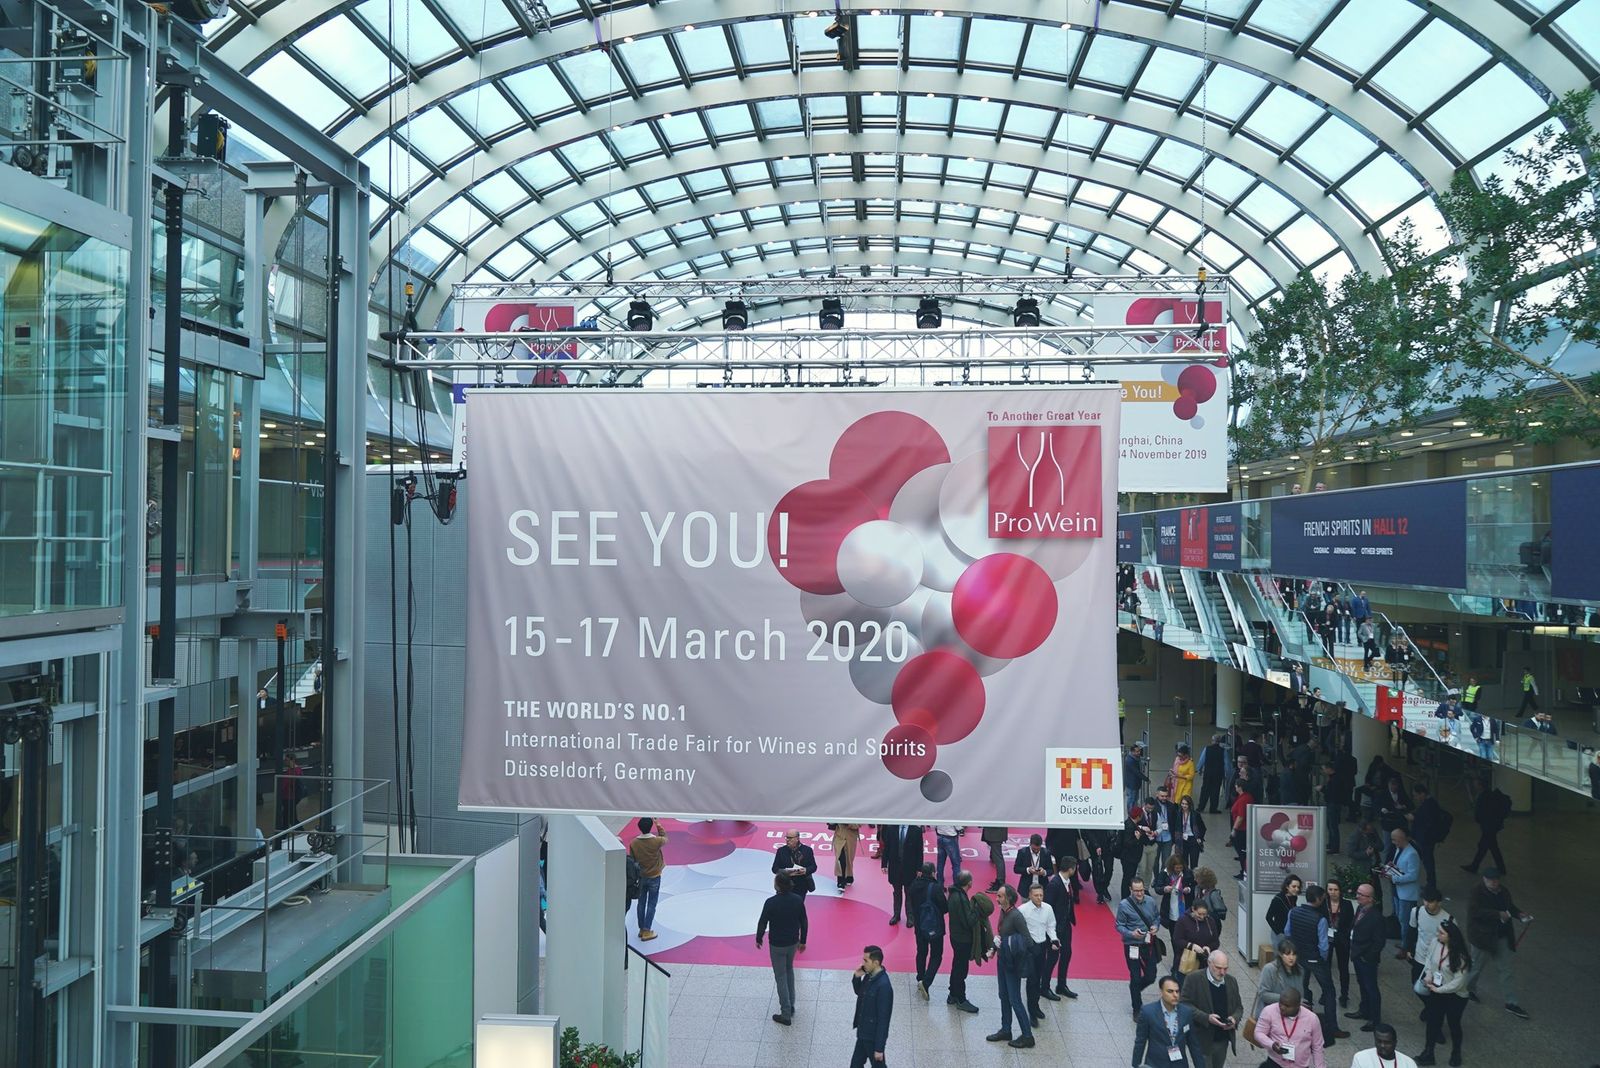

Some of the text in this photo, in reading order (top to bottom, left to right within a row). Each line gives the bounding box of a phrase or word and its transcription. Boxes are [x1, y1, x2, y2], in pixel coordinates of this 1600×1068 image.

[1133, 384, 1162, 398] You!
[987, 411, 1102, 421] To Another Great Year
[1120, 435, 1183, 447] nghai, China
[1130, 449, 1182, 460] November
[1185, 449, 1207, 460] 2019
[994, 512, 1097, 534] ProWein
[1303, 518, 1408, 537] FRENCH SPIRITS IN HALL 12
[506, 510, 789, 569] SEE YOU!
[1333, 547, 1356, 555] ARMAGNAC
[1361, 547, 1376, 555] OTHER
[1376, 547, 1393, 555] SPIRITS
[640, 617, 786, 661] March
[805, 620, 909, 663] 2020
[505, 700, 686, 721] THE WORLD'S NO.1
[505, 730, 926, 760] International Trade Fair for Wines and Spirits
[505, 758, 696, 786] Düsseldorf, Germany
[1060, 792, 1090, 802] Messe
[1060, 804, 1113, 816] Düsseldorf
[1259, 849, 1295, 857] SEE YOU!
